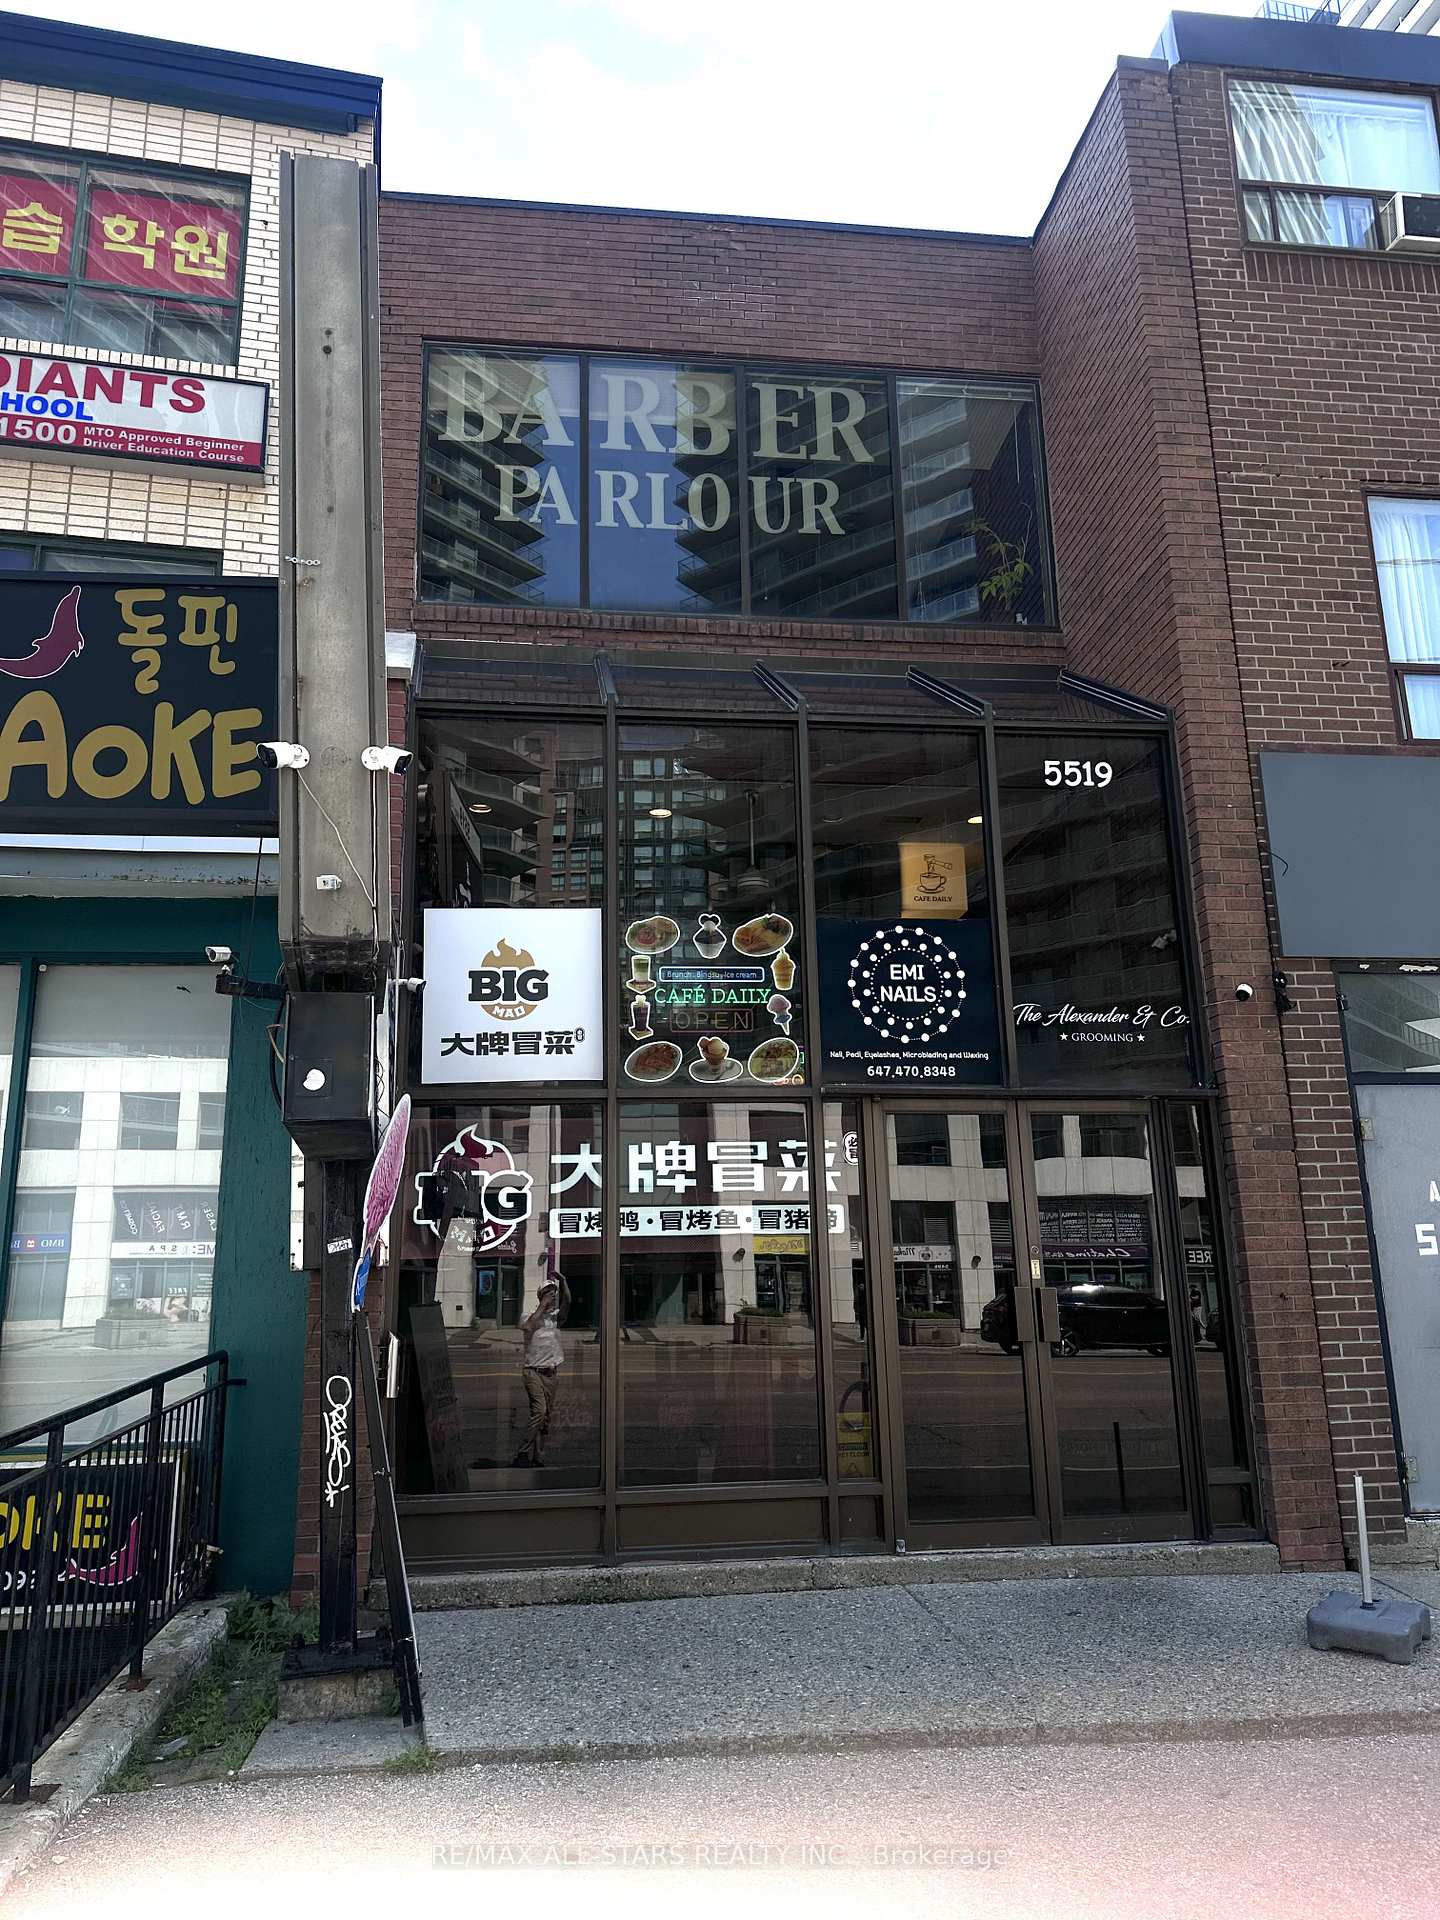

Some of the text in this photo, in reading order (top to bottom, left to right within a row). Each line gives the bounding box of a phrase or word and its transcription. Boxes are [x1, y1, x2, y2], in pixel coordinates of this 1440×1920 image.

[102, 213, 229, 280] 학원
[437, 362, 874, 463] BARBER
[83, 425, 244, 453] MTO Approved Beginner
[83, 437, 245, 463] Driver Education Course
[494, 464, 846, 535] PARLOUR
[114, 588, 238, 694] 돌핀
[1043, 760, 1113, 788] 5519
[932, 895, 952, 903] DAILY
[890, 964, 925, 980] EMI
[468, 969, 550, 1002] BIG
[654, 984, 772, 1004] CAFÉ DAILY
[880, 985, 937, 1002] NAILS
[675, 1011, 749, 1029] OPEN
[1013, 1003, 1042, 1025] The
[1042, 1003, 1130, 1026] Alexander
[1160, 1005, 1191, 1028] Co.
[440, 1031, 575, 1057] 大牌冒菜
[1071, 1032, 1134, 1043] GROOMING
[902, 1051, 948, 1060] Microblading
[962, 1052, 989, 1060] Waxing
[867, 1065, 956, 1078] 647.470.8348
